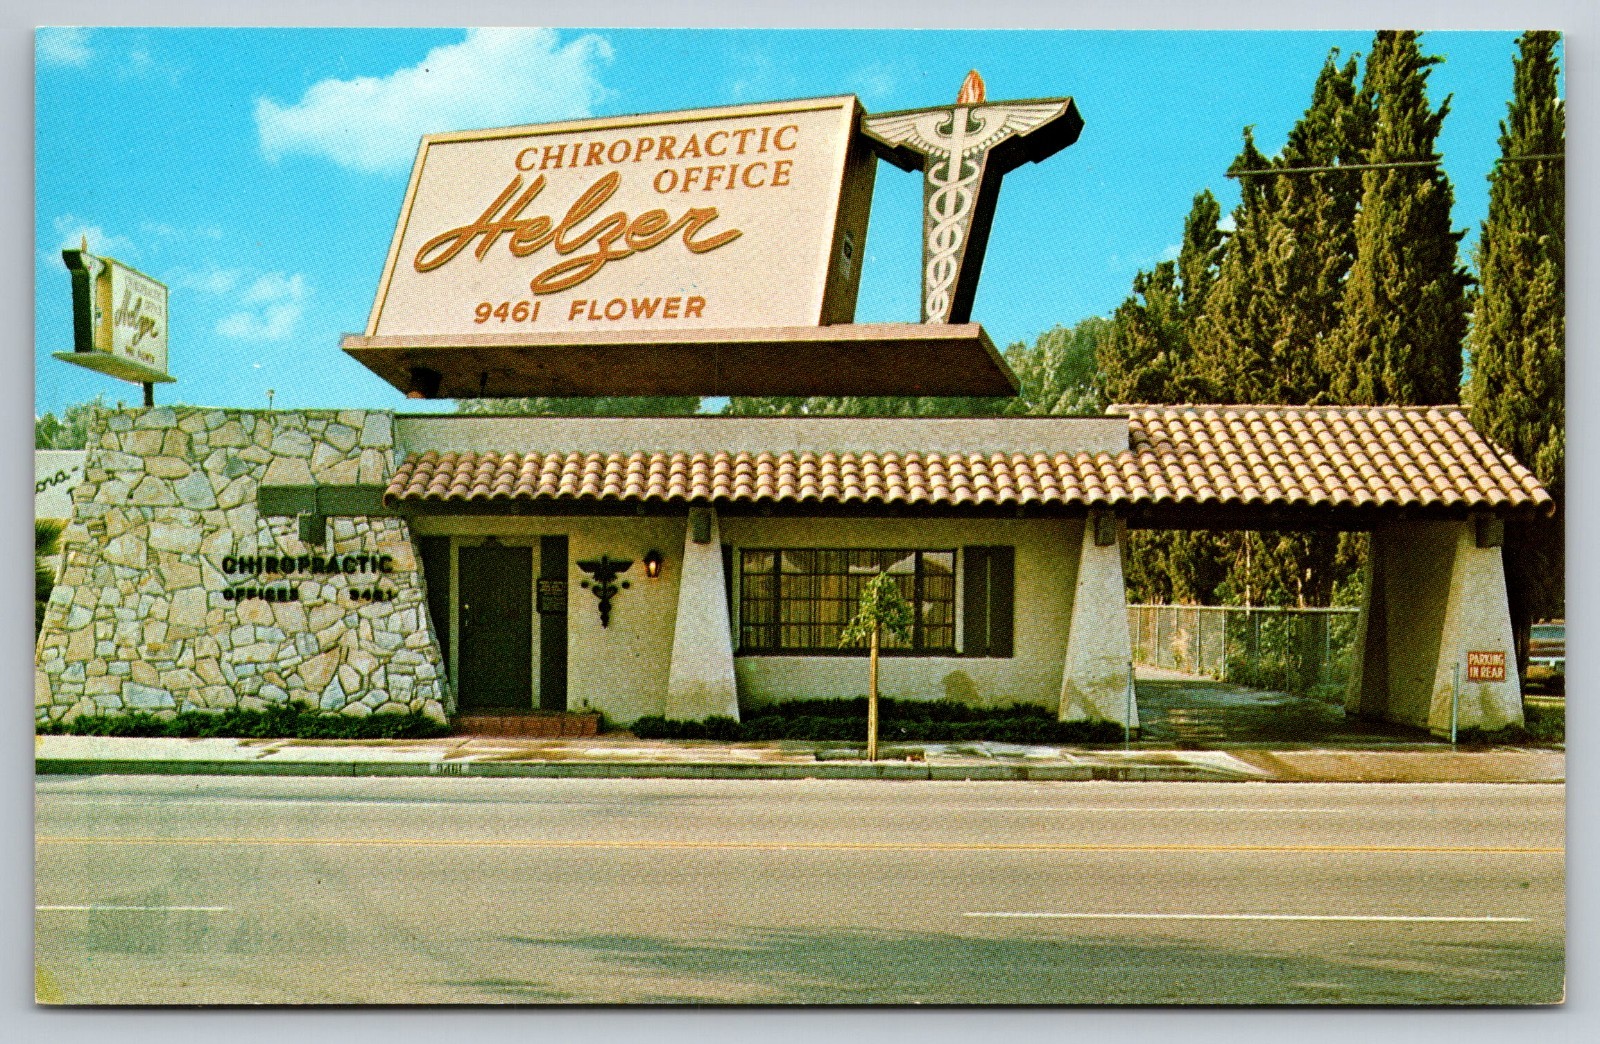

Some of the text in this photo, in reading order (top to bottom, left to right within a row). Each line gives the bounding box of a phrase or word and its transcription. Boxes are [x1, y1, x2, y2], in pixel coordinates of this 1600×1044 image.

[515, 125, 800, 173] CHIROPRACTIC
[654, 159, 795, 194] OFFICE
[414, 171, 743, 295] Helzer
[473, 295, 707, 323] 9461 FLOWER
[221, 553, 393, 575] CHIROPRACTIC
[1469, 653, 1505, 665] PARKING
[1470, 666, 1504, 678] IN REAR
